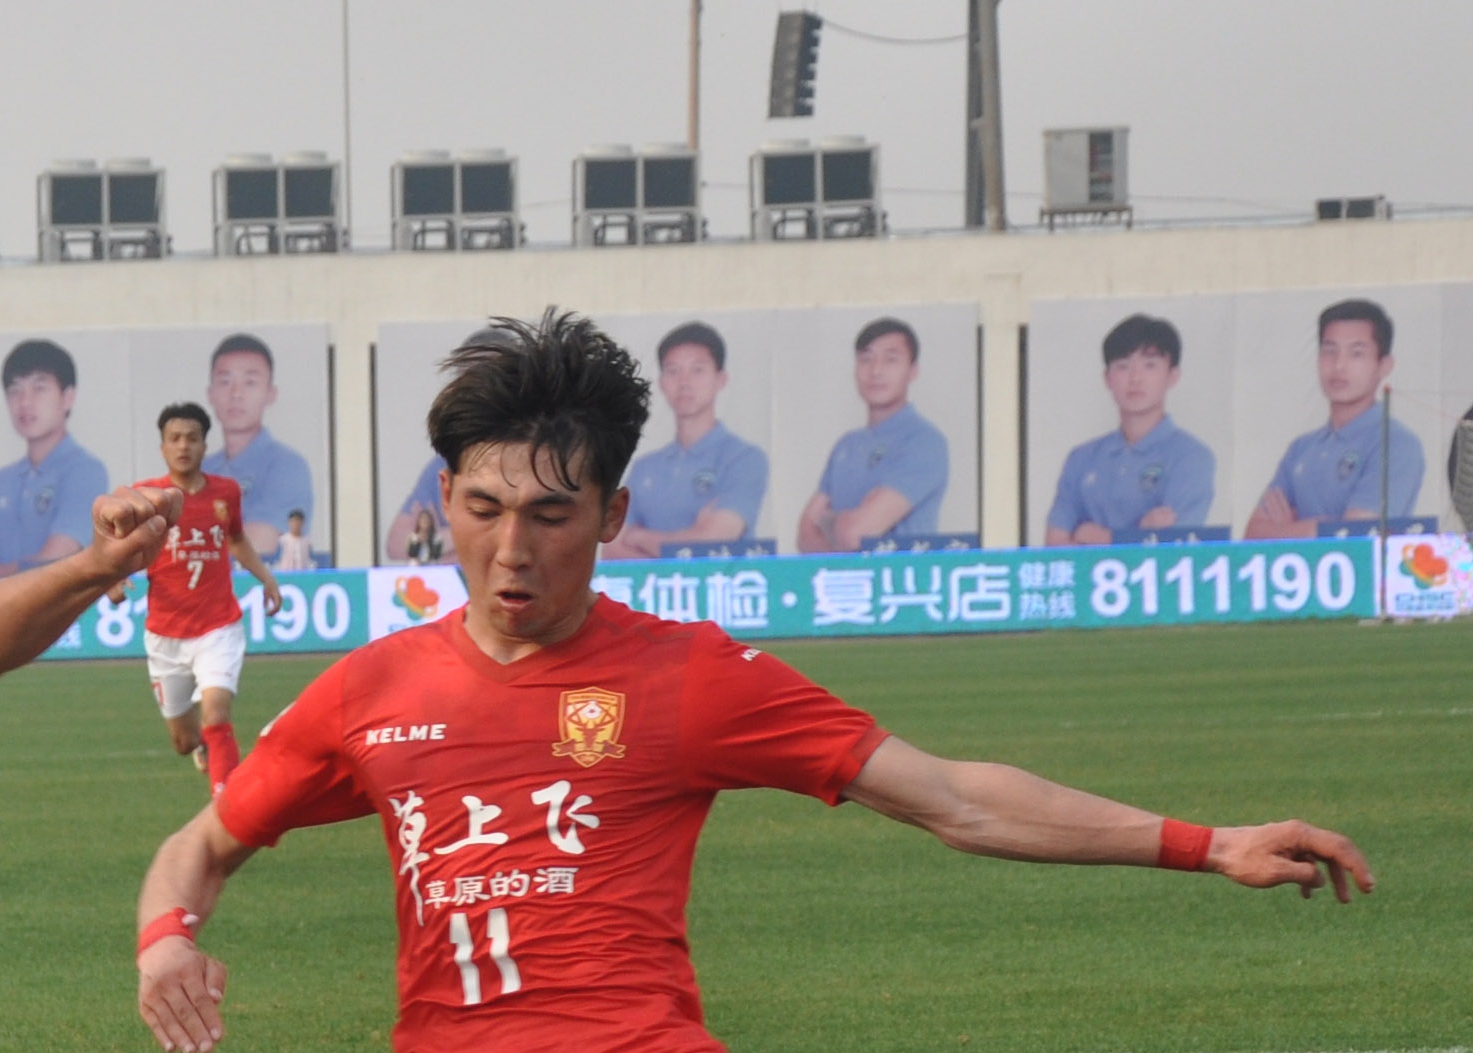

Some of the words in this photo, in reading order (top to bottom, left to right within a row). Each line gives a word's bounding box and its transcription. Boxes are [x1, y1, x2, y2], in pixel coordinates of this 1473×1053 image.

[187, 560, 204, 590] 7
[1090, 551, 1356, 617] 8111190
[366, 723, 447, 746] KELME
[424, 866, 579, 909] 草原的酒
[449, 907, 521, 1006] 11
